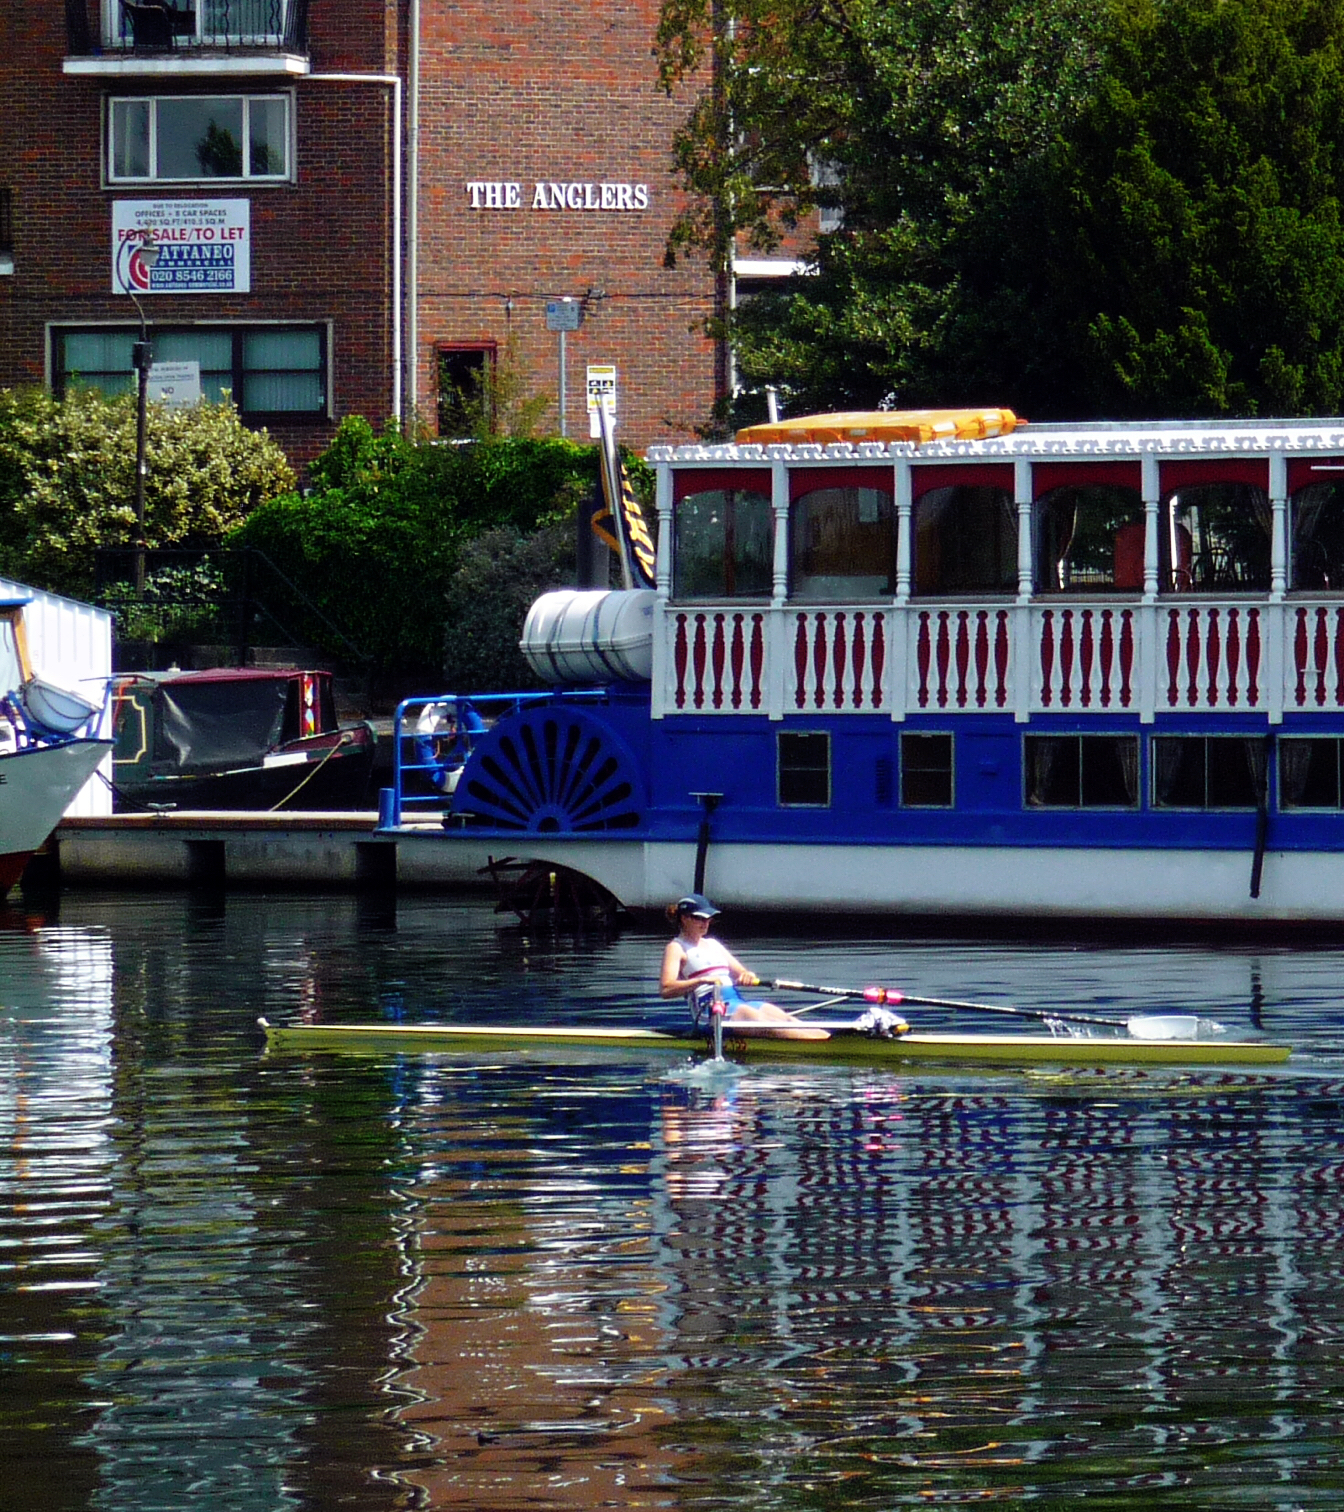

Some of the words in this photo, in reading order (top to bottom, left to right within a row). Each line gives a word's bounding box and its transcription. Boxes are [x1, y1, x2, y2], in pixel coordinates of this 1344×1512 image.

[467, 182, 521, 209] THE
[532, 183, 648, 209] ANGLERS
[135, 210, 165, 218] OFFICES
[199, 209, 227, 217] SPACES
[152, 228, 215, 242] SALE/TO
[220, 227, 245, 240] LET
[160, 245, 233, 260] ATTANEO
[151, 270, 173, 281] 020
[175, 270, 205, 281] 8546
[206, 269, 233, 281] 2166
